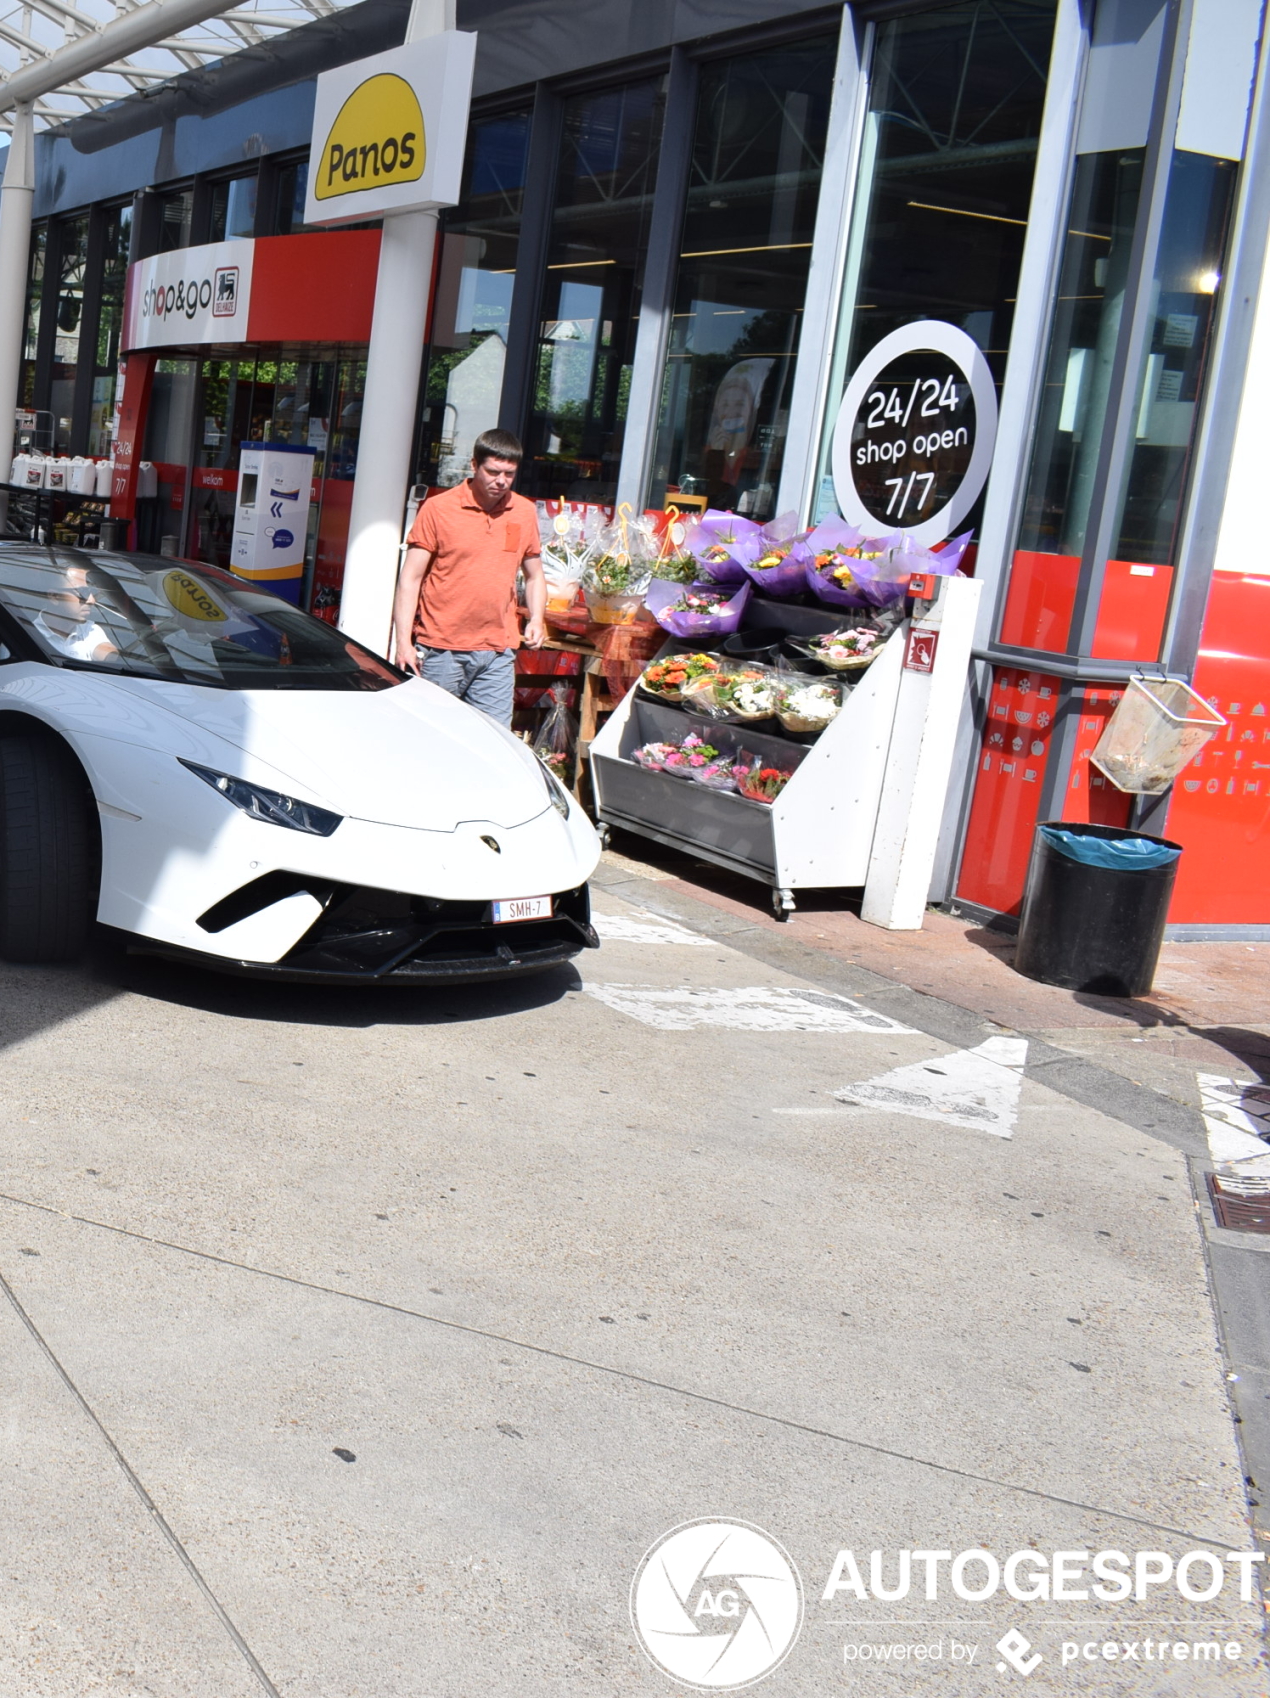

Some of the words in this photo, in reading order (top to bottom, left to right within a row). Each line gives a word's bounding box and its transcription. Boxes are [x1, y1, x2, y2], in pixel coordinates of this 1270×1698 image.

[327, 131, 416, 187] Panos
[142, 278, 212, 323] shop&go
[215, 301, 234, 313] DELHAIZE
[867, 374, 959, 429] 24/24
[116, 441, 132, 456] 24/24
[856, 439, 906, 466] shop
[912, 426, 968, 458] open
[115, 477, 127, 495] 7/7
[202, 473, 224, 486] welkom
[885, 470, 935, 519] 7/7
[509, 900, 541, 918] SMH-7
